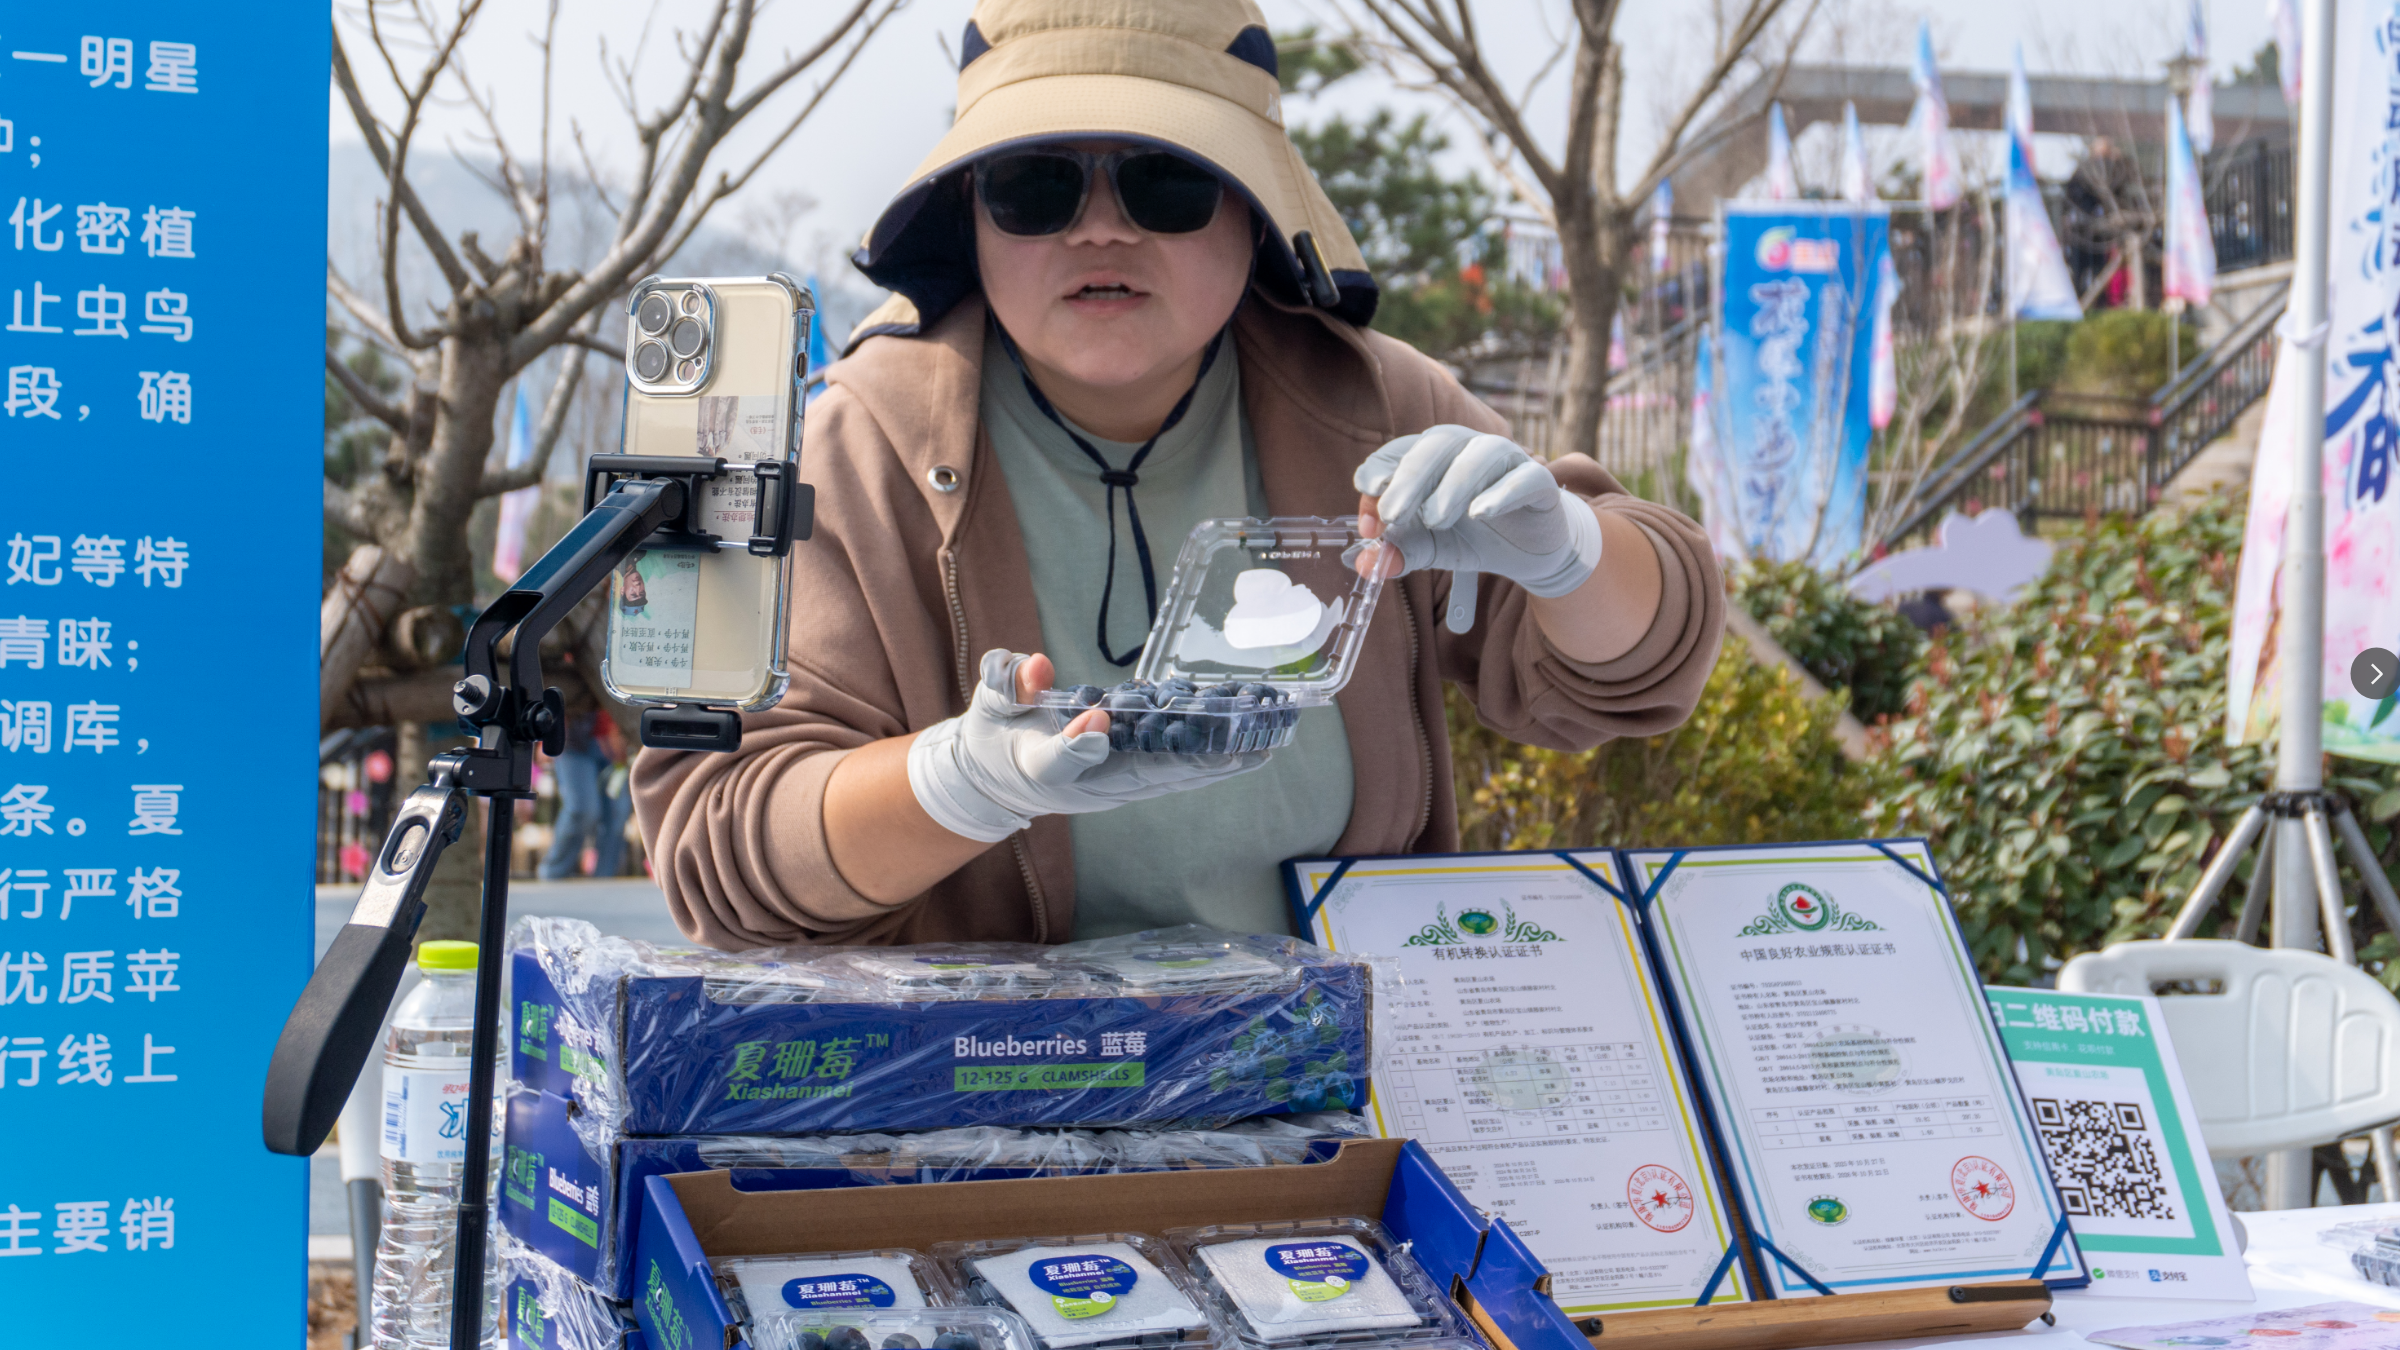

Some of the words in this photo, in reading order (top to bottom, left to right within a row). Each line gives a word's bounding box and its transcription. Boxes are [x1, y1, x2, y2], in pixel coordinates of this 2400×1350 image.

[9, 196, 197, 259] 化密植
[6, 281, 194, 342] 止虫鸟
[7, 532, 190, 588] 妃等特
[0, 615, 139, 672] 青睐；
[0, 698, 149, 755] 调库，
[0, 866, 183, 921] 行严格
[1432, 945, 1543, 960] 有机转换认证证书
[1740, 943, 1898, 961] 中国良好农业规范认证证书
[0, 948, 181, 1005] 优质苹
[725, 1036, 862, 1080] 夏珊莓
[955, 1034, 1087, 1058] Blueberries
[1100, 1031, 1147, 1057] 蓝莓
[0, 1033, 178, 1088] 行线上
[1415, 1057, 1441, 1065] 基地名称
[724, 1080, 852, 1101] Xiashanmei
[960, 1070, 1012, 1086] 12-125
[1018, 1071, 1029, 1084] G
[1042, 1068, 1129, 1085] CLAMSHELLS
[549, 1167, 584, 1204] Blueberries
[0, 1196, 175, 1257] 主要销
[1278, 1247, 1334, 1260] 夏珊莓
[1284, 1256, 1337, 1265] Xiashanmei
[1043, 1261, 1099, 1276] 夏珊莓
[1048, 1271, 1104, 1281] Xiashanmei
[798, 1280, 857, 1294] 夏珊莓
[801, 1290, 861, 1299] Xiashanmei
